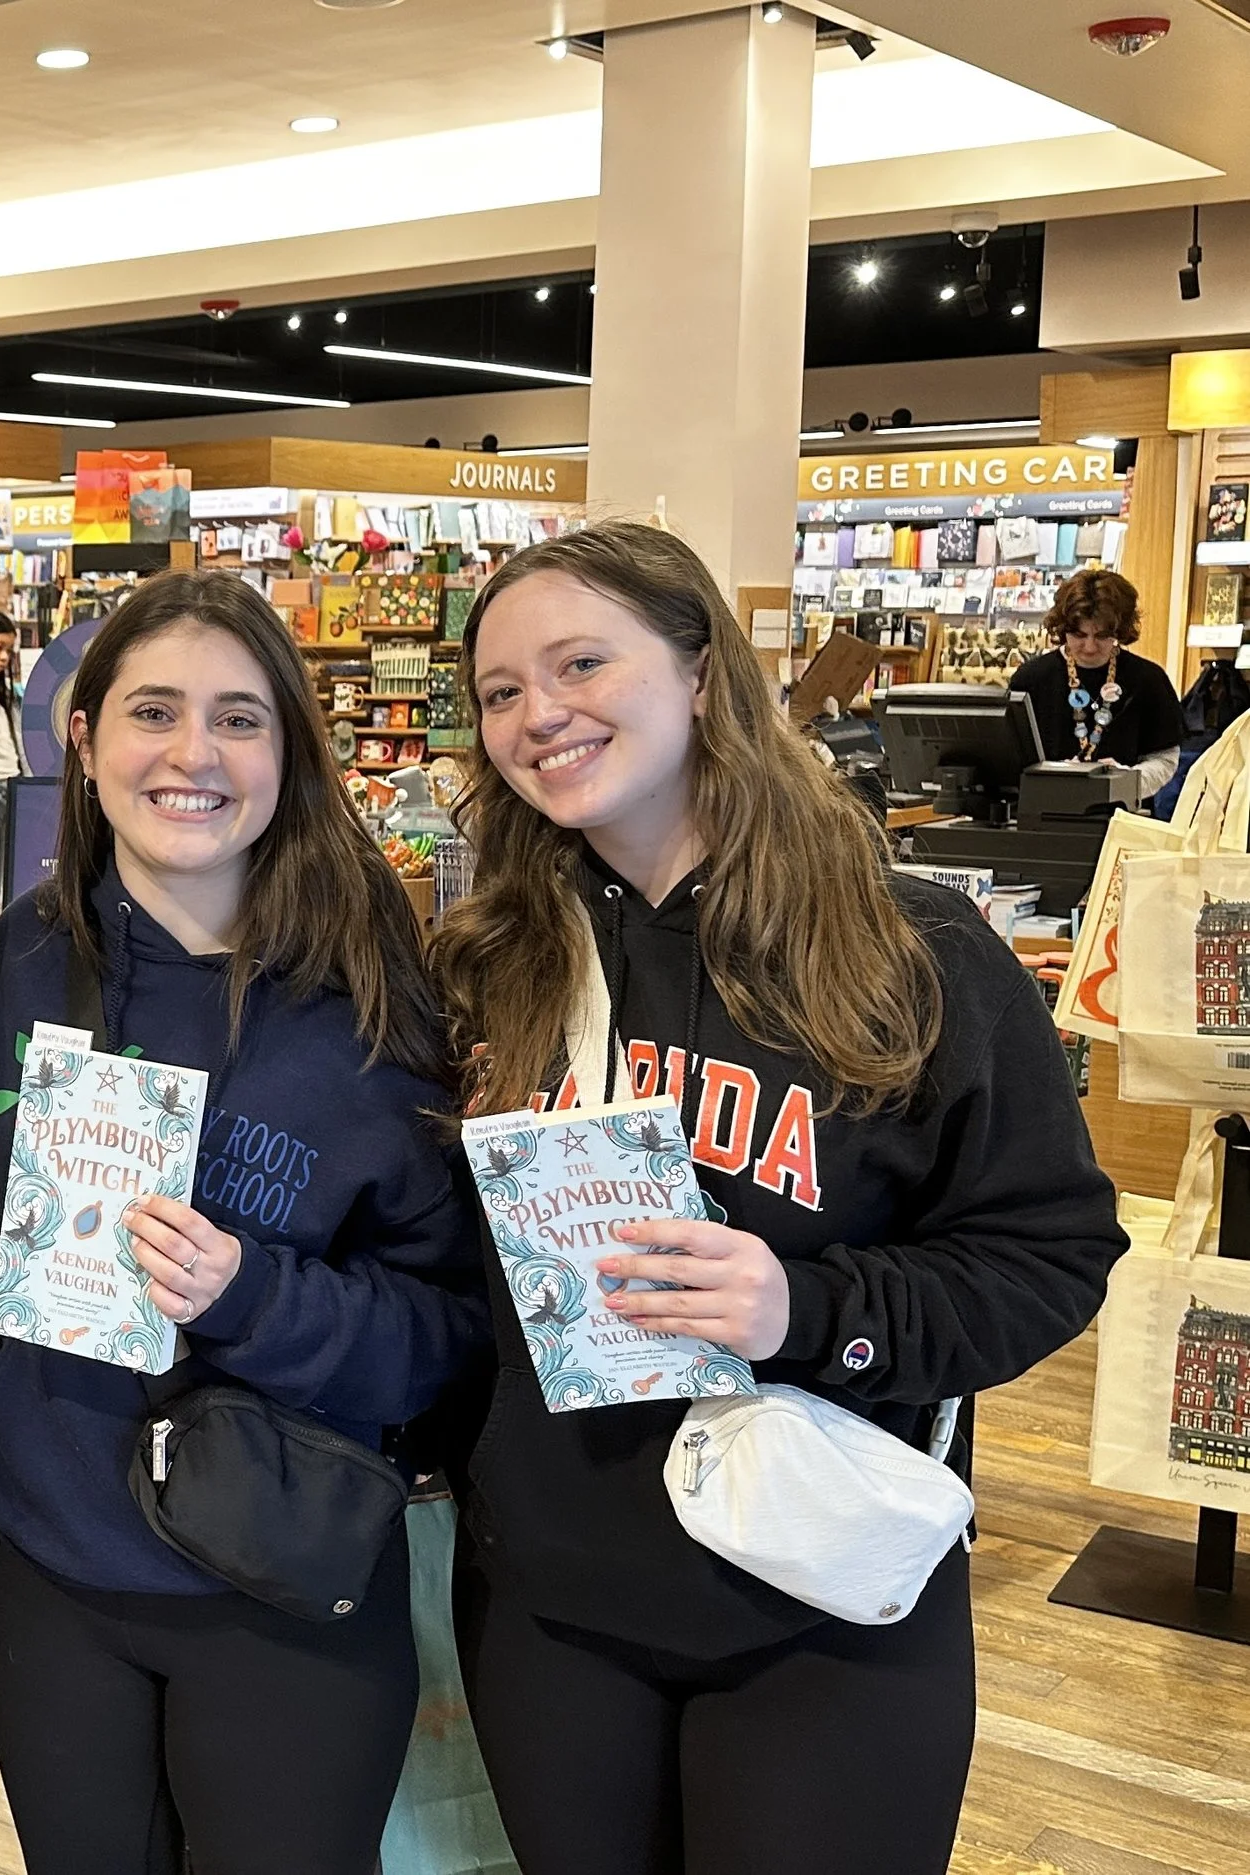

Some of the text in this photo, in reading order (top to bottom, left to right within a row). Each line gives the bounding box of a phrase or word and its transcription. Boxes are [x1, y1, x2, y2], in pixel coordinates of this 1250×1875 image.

[449, 460, 557, 493] JOURNALS
[811, 455, 1127, 492] GREETING CAR
[884, 504, 944, 516] Greeting Cards
[1048, 499, 1113, 512] Greeting Cards
[932, 871, 970, 884] SOUNDS
[91, 1098, 119, 1116] THE
[31, 1117, 169, 1173] PLYMBURY
[221, 1114, 319, 1190] ROOTS
[47, 1148, 142, 1195] WITCH
[563, 1161, 598, 1178] THE
[507, 1180, 675, 1236] PLYMBURY
[52, 1249, 116, 1277] KENDRA
[44, 1268, 119, 1298] VAUGHAN
